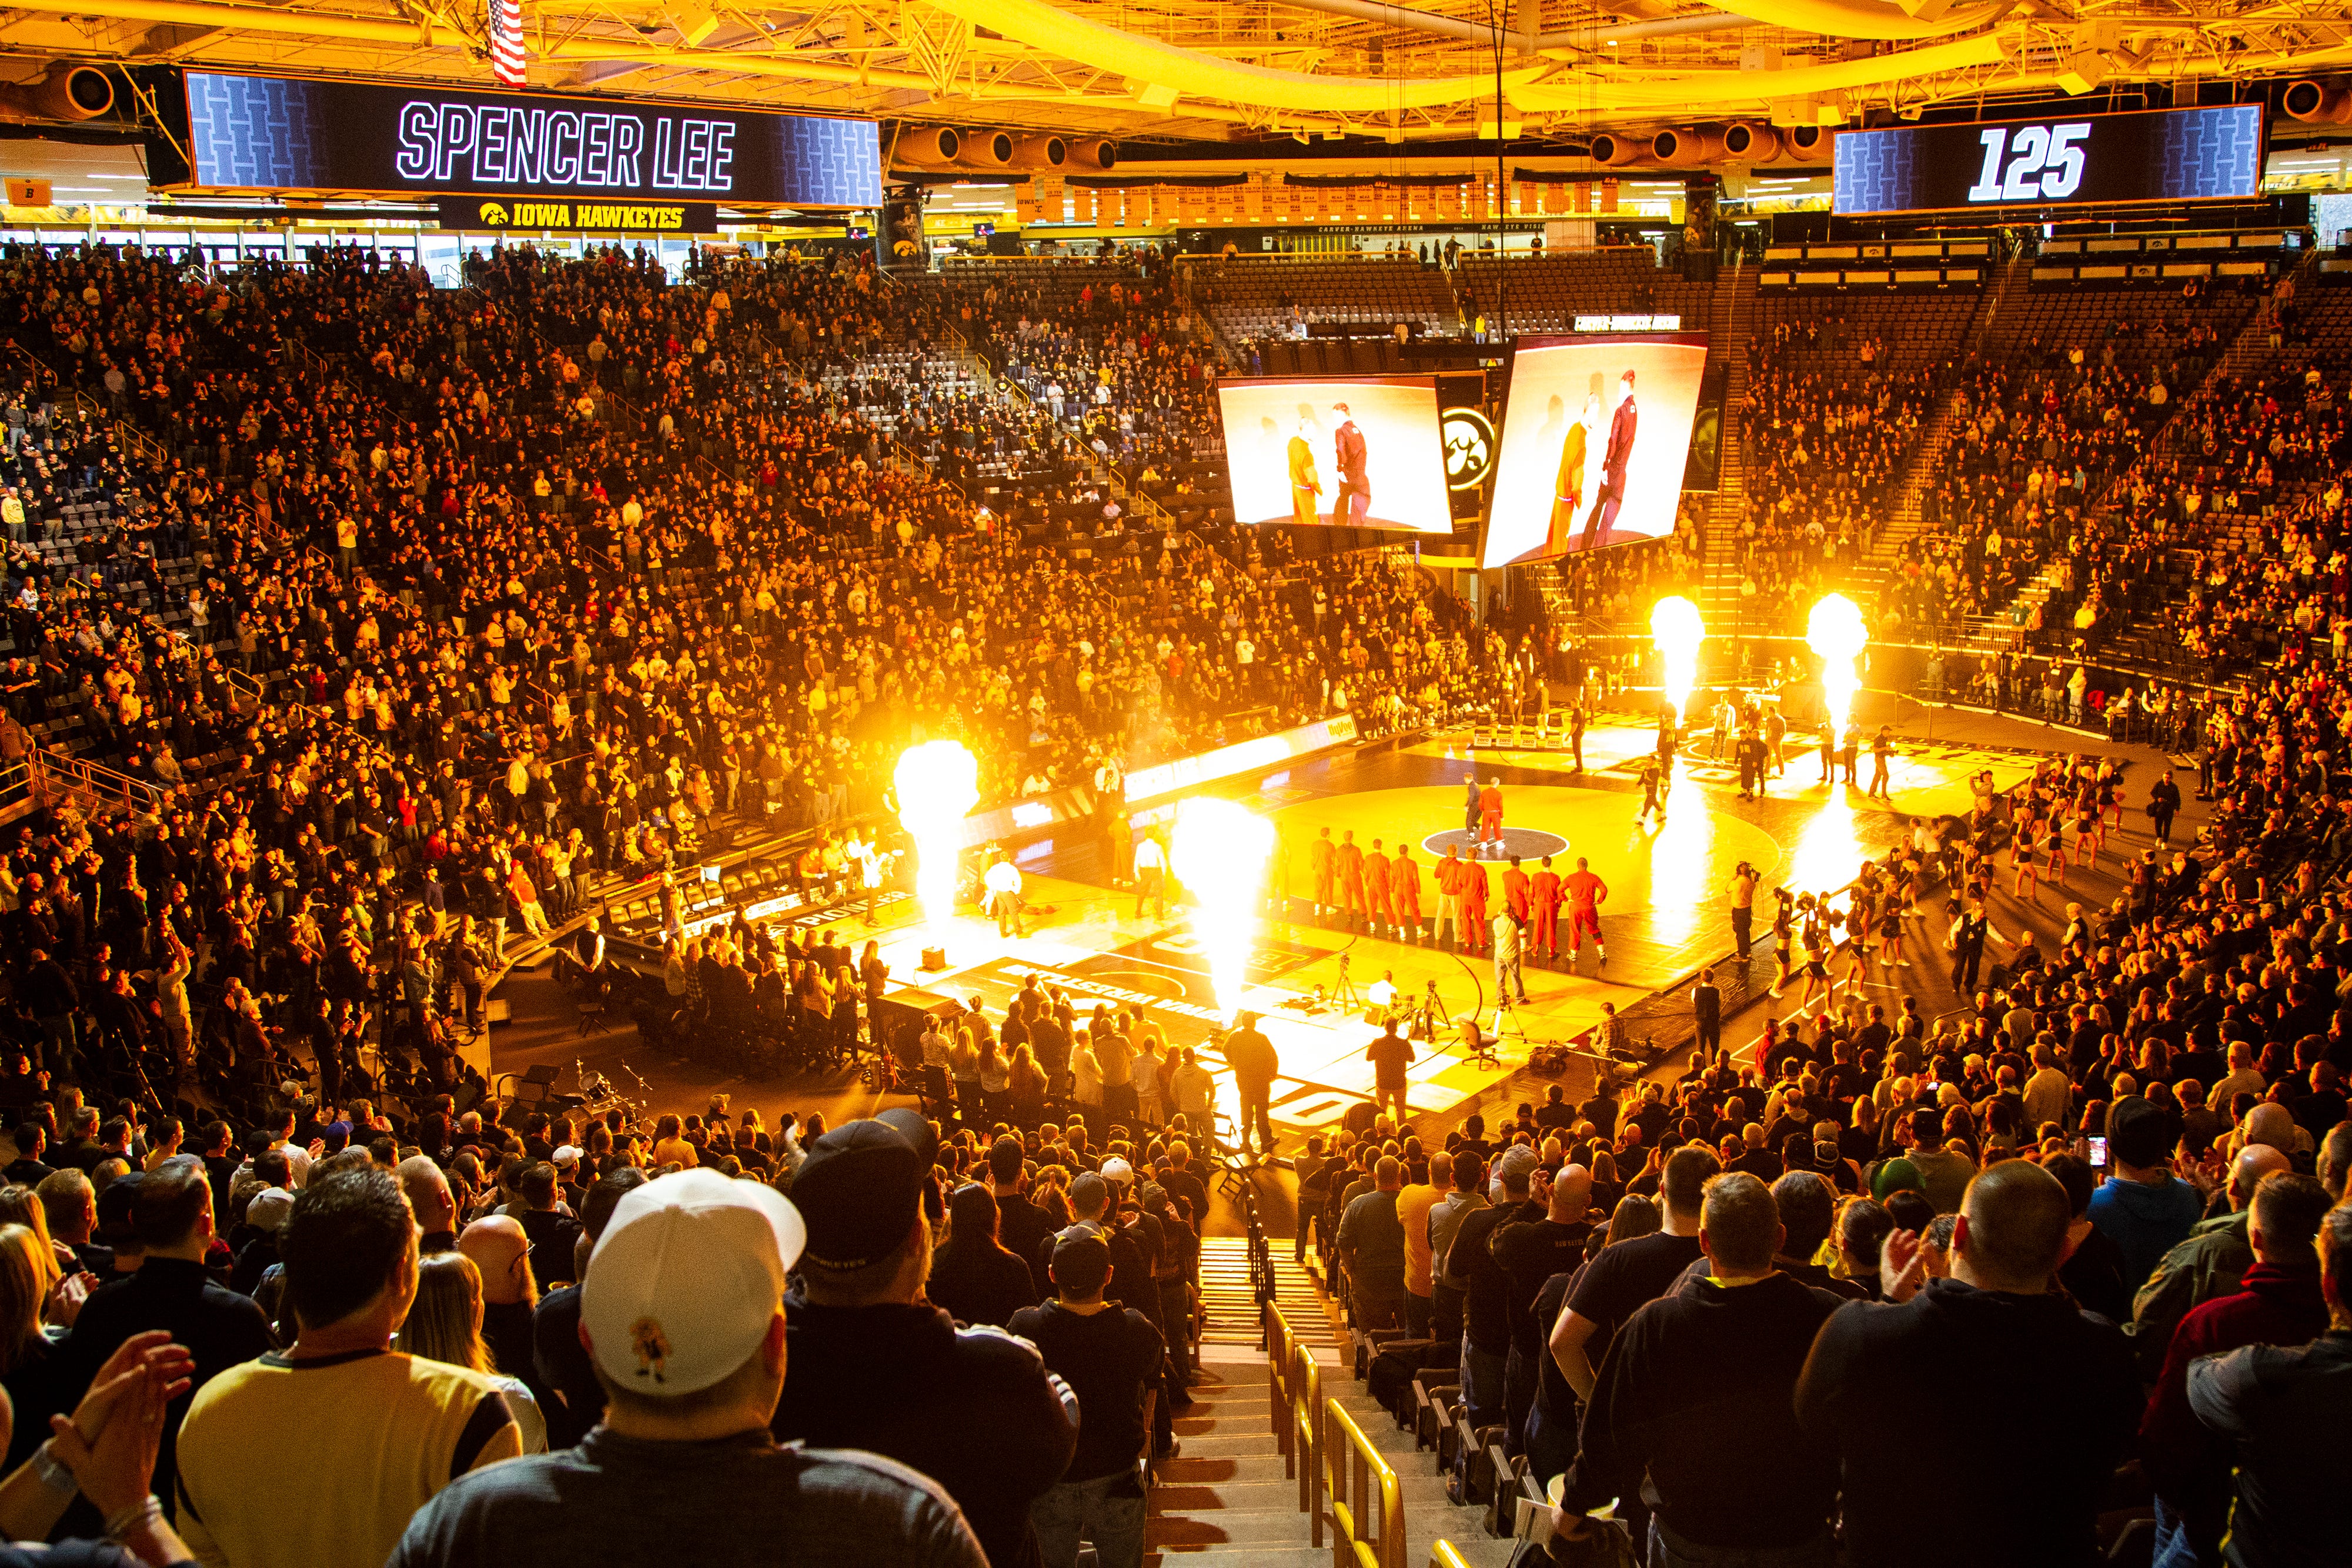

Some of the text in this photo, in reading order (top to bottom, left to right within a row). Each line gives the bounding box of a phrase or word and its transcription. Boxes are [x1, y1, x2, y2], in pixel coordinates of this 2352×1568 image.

[396, 101, 736, 192] SPENCER LEE
[1967, 122, 2092, 202] 125
[513, 203, 685, 229] IOWA HAWKEYES
